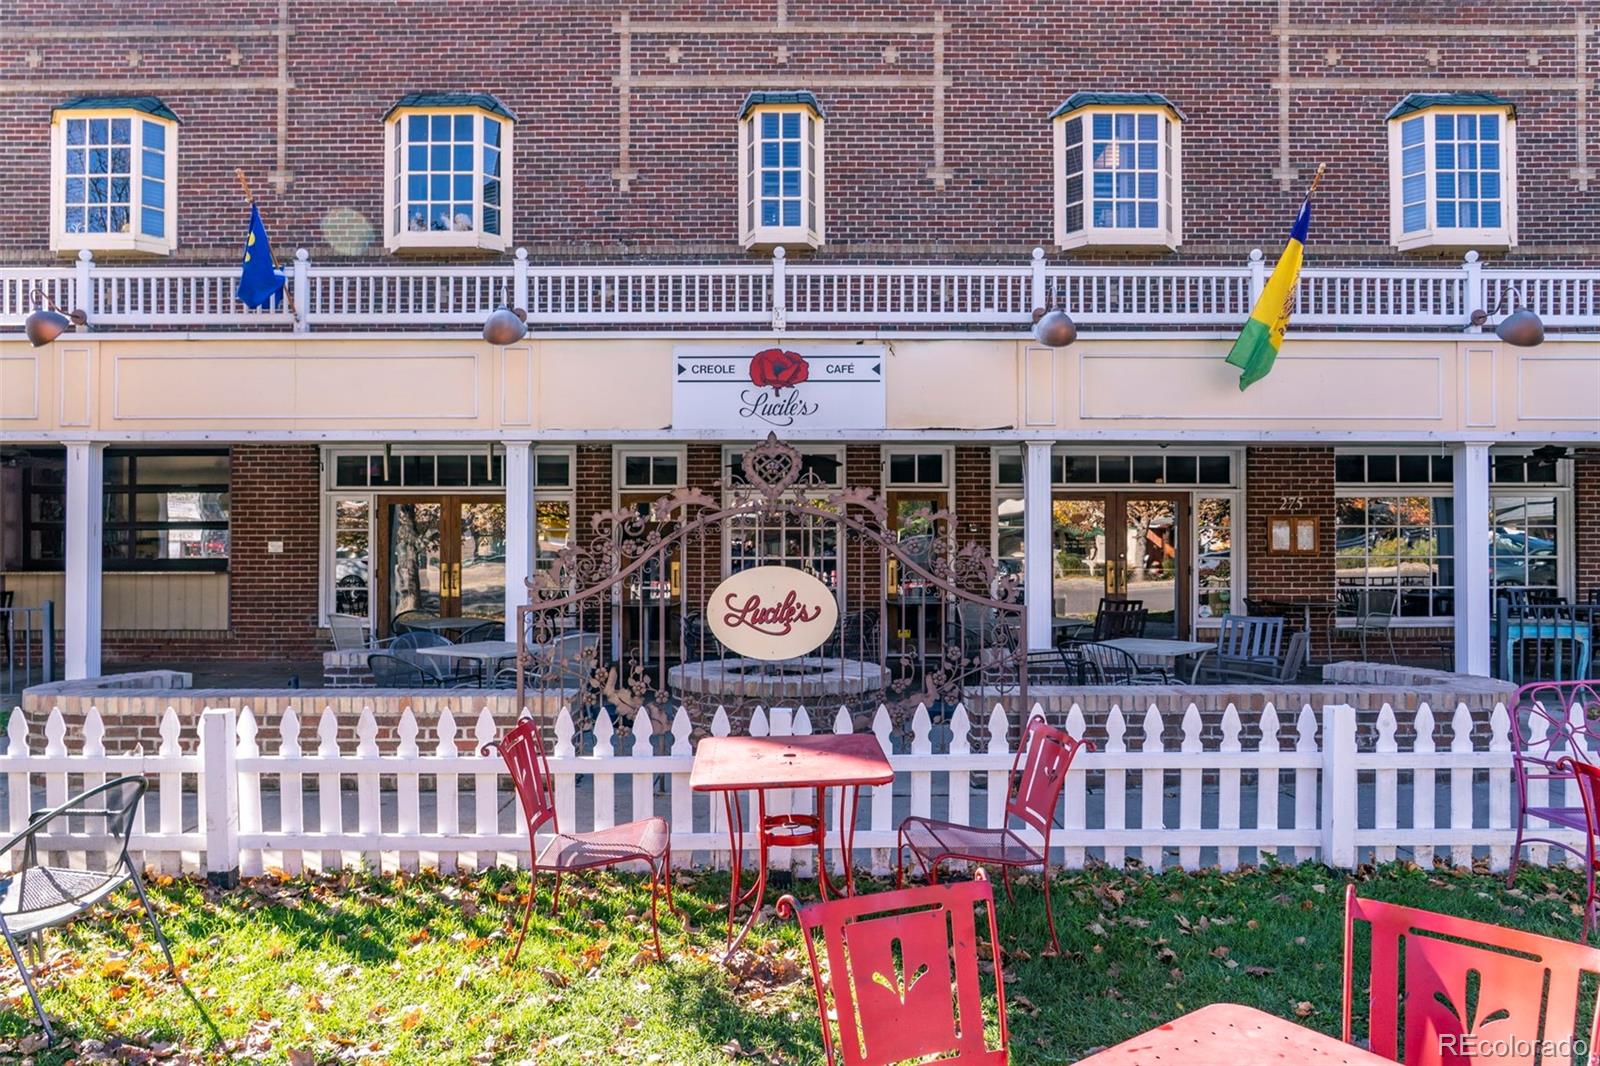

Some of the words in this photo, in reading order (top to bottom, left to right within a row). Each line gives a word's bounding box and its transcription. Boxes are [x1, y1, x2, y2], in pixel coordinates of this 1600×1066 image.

[691, 364, 736, 375] CREOLE
[826, 362, 855, 375] CAFÉ
[739, 389, 819, 427] Lucile's
[1279, 496, 1304, 511] 275
[723, 589, 822, 637] Lucile's
